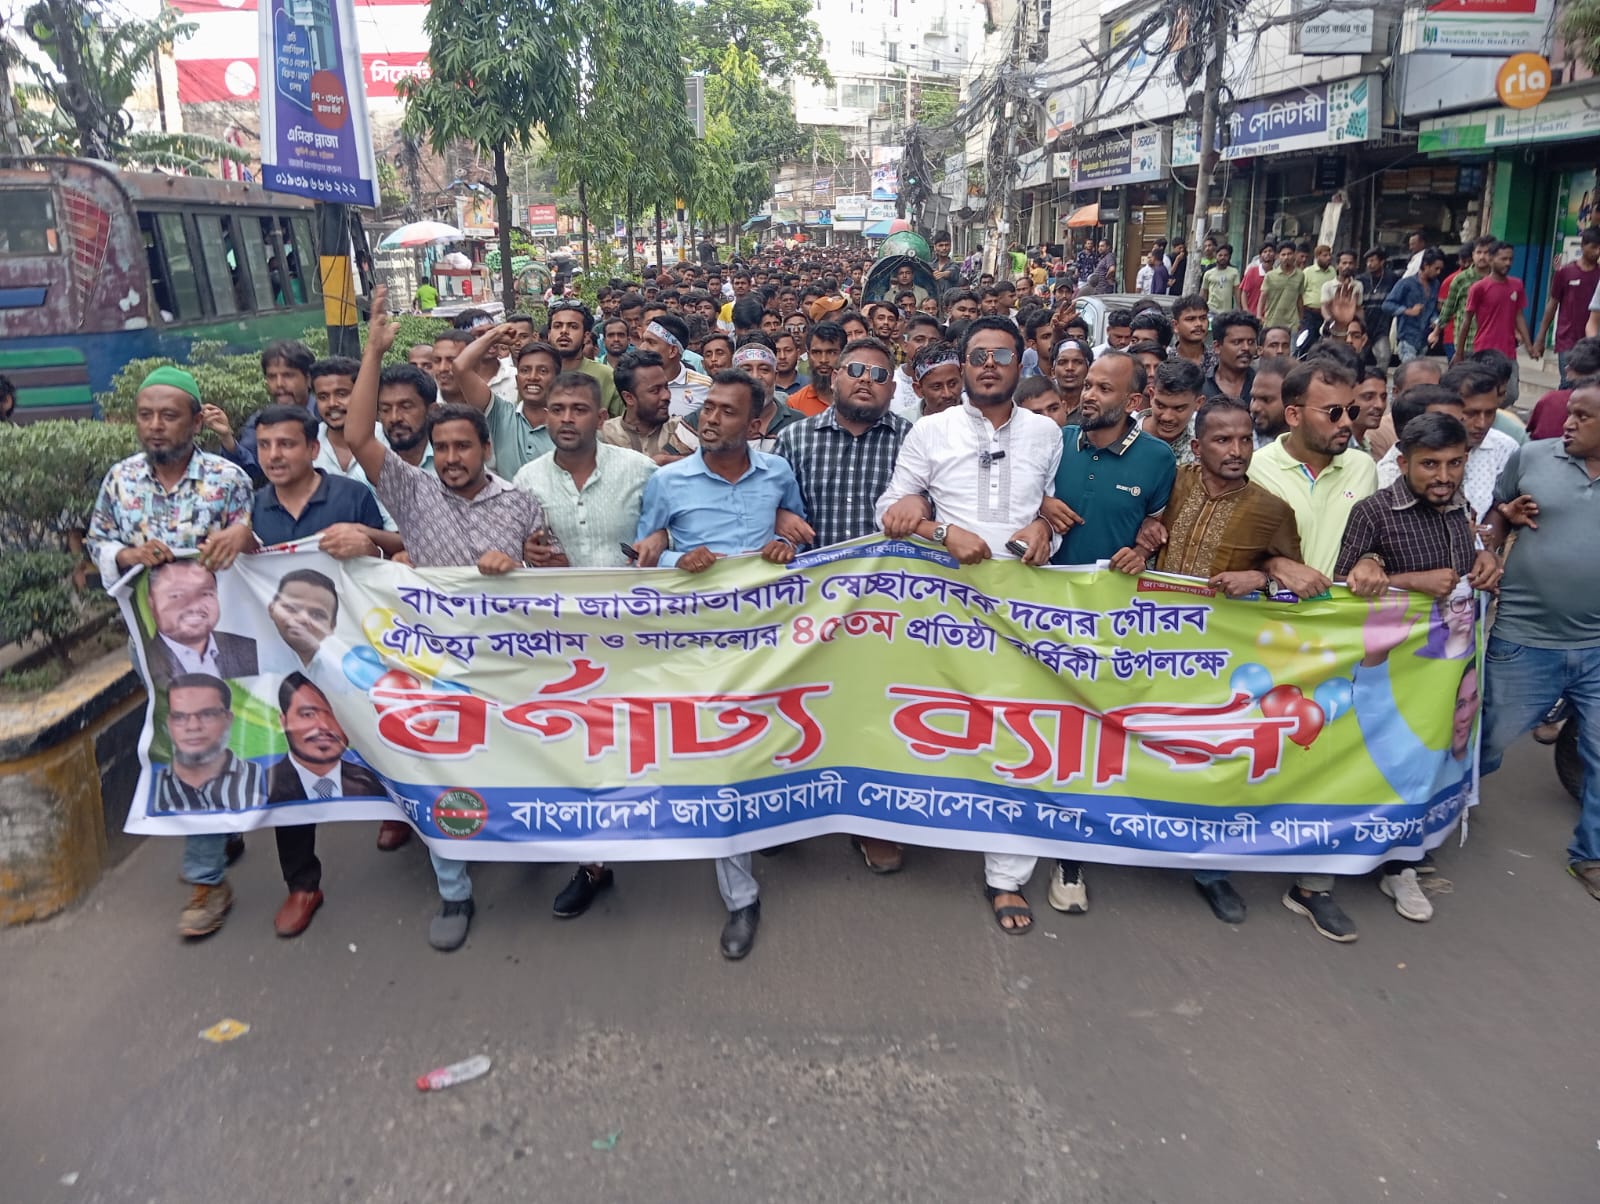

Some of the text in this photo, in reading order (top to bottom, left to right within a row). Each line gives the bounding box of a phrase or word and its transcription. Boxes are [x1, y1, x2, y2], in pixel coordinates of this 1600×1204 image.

[1505, 63, 1546, 94] ria
[1249, 93, 1326, 133] সেনিটারী
[310, 178, 332, 192] ৬৬৬
[334, 181, 357, 197] ২২২
[397, 570, 1210, 637] বাংলাদেশ জাতীয়াতাবাদী স্বেচ্ছাসেবক দলের গৌরব
[382, 617, 480, 664] ঐতিহ্য
[487, 629, 590, 657] সংগ্রাম
[600, 633, 625, 649] ও
[791, 610, 901, 645] ৪৫তম
[907, 613, 997, 653] প্রতিষ্ঠা
[1111, 648, 1230, 679] উপলক্ষে
[369, 658, 832, 778] বর্ণাঢ্য
[507, 796, 660, 832] বাংলাদেশ
[668, 770, 848, 828] জাতীয়তাবাদী
[858, 782, 1026, 824] সেচ্ছাসেবক
[1036, 802, 1093, 838] দল,
[1106, 811, 1261, 844] কোতোয়ালী
[1270, 816, 1340, 849] থানা,
